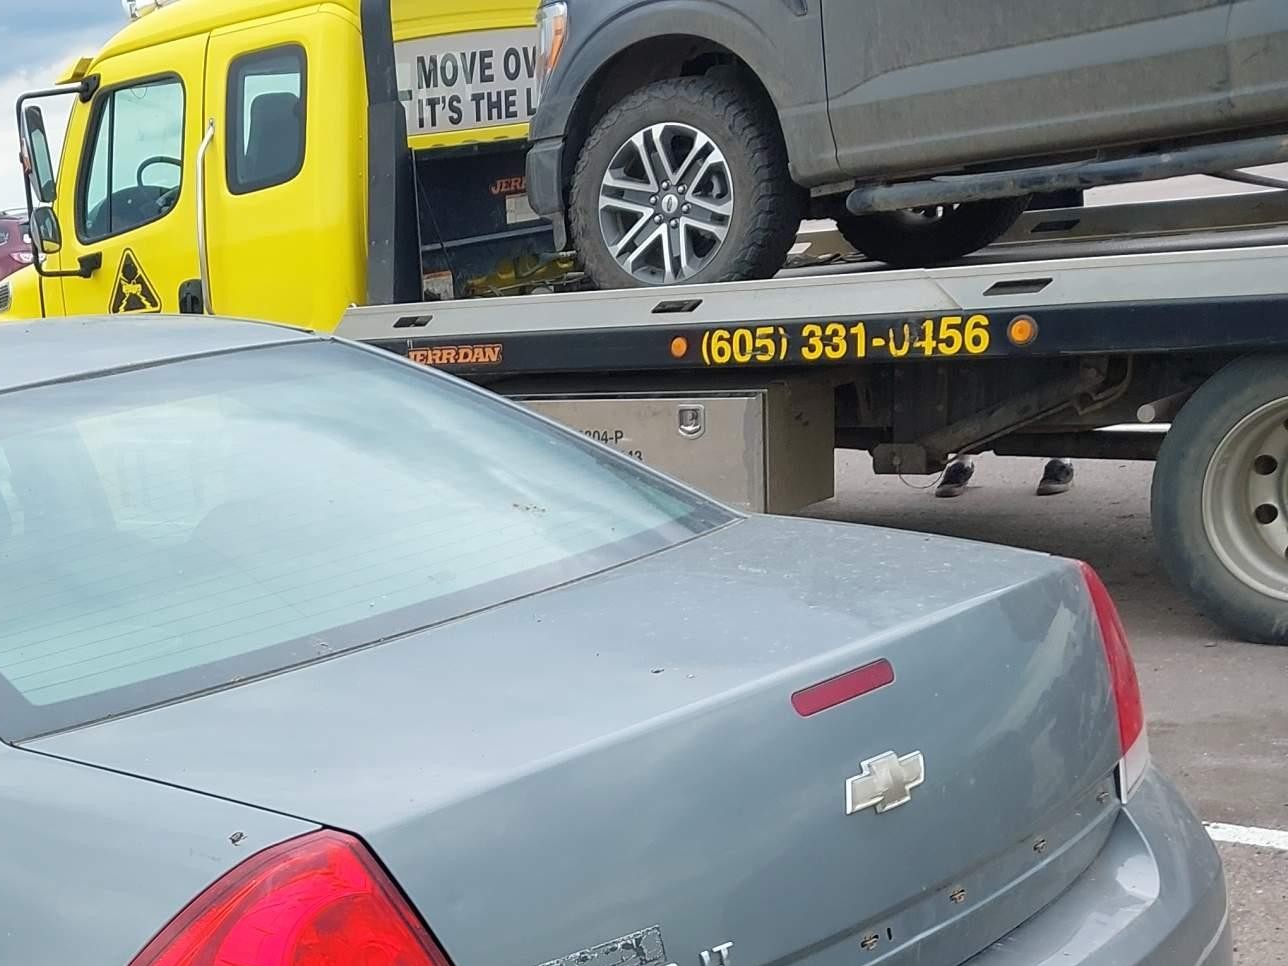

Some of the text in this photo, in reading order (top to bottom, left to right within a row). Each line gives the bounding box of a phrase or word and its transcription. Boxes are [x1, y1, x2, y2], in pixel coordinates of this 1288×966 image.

[416, 45, 537, 90] MOVE OV
[417, 94, 464, 129] IT'S
[470, 89, 518, 123] THE
[491, 177, 526, 194] JER
[701, 314, 991, 365] (605) 331-0456
